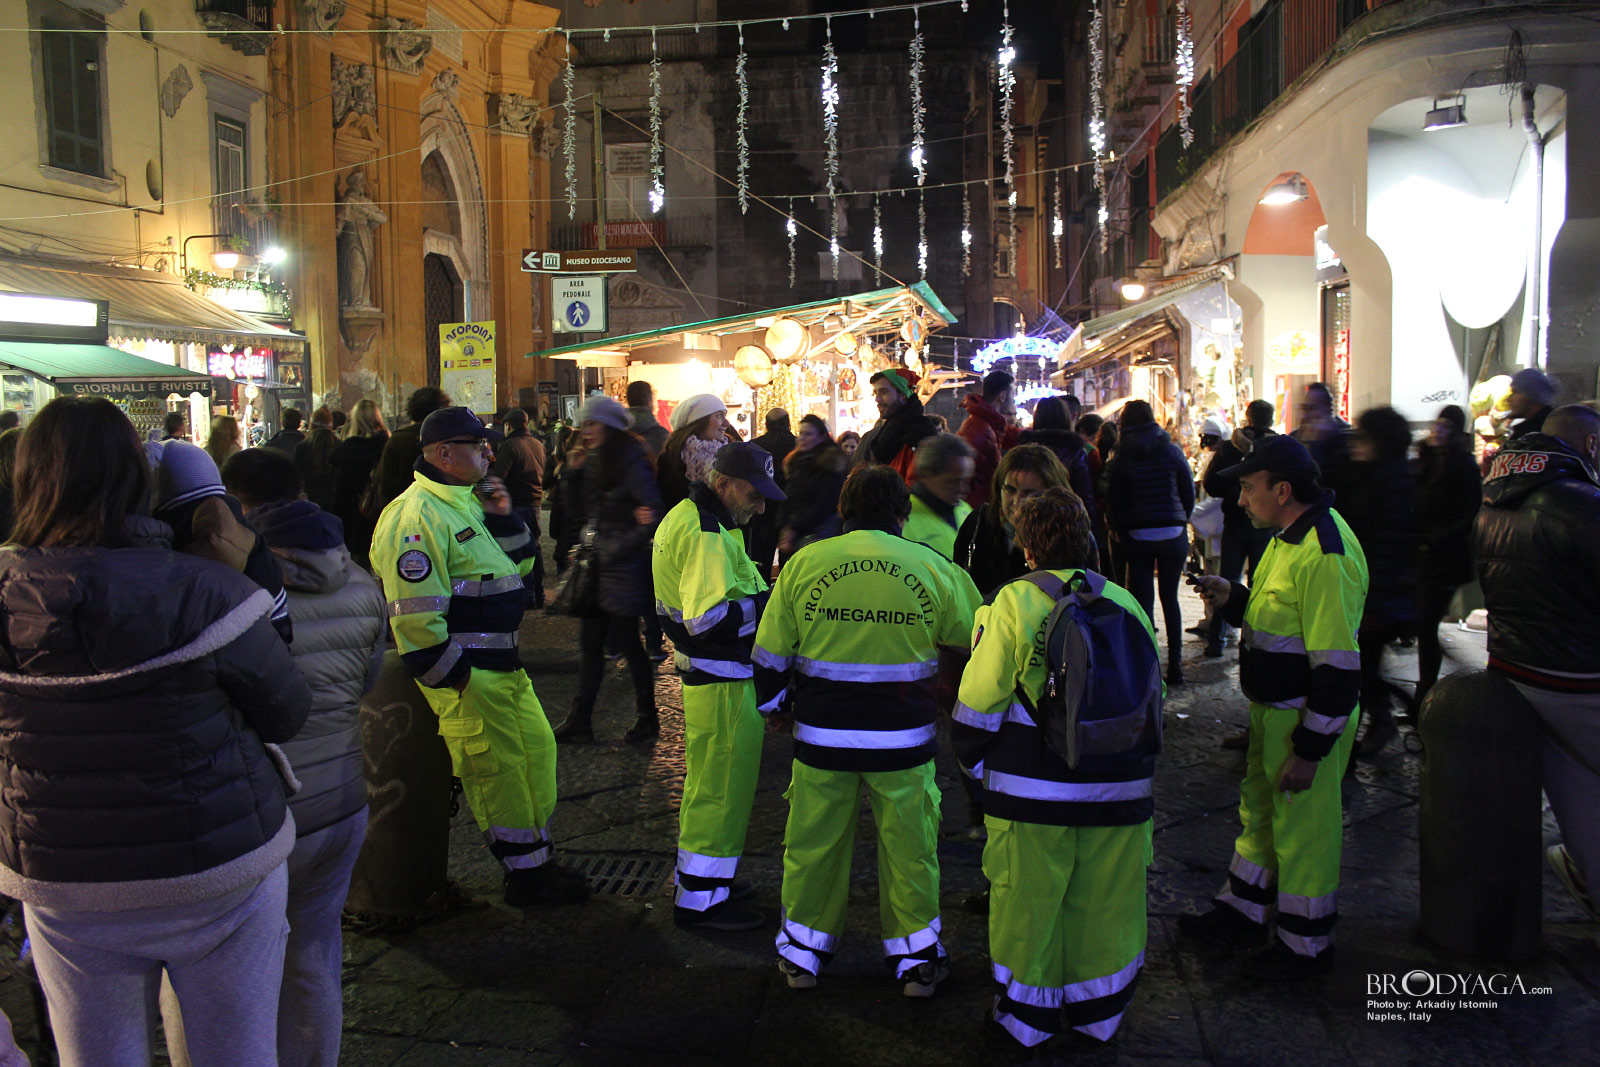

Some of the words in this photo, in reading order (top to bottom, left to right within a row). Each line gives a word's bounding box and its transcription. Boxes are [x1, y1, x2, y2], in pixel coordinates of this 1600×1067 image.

[591, 256, 632, 265] DIOCESANO
[562, 290, 591, 298] PEDONALE
[73, 382, 144, 393] GIORNALI
[148, 382, 157, 392] E
[161, 380, 209, 391] RIVISTE
[804, 558, 901, 622] PROTEZIONE
[902, 573, 935, 630] CIVILE
[818, 606, 924, 626] "MEGARIDE"
